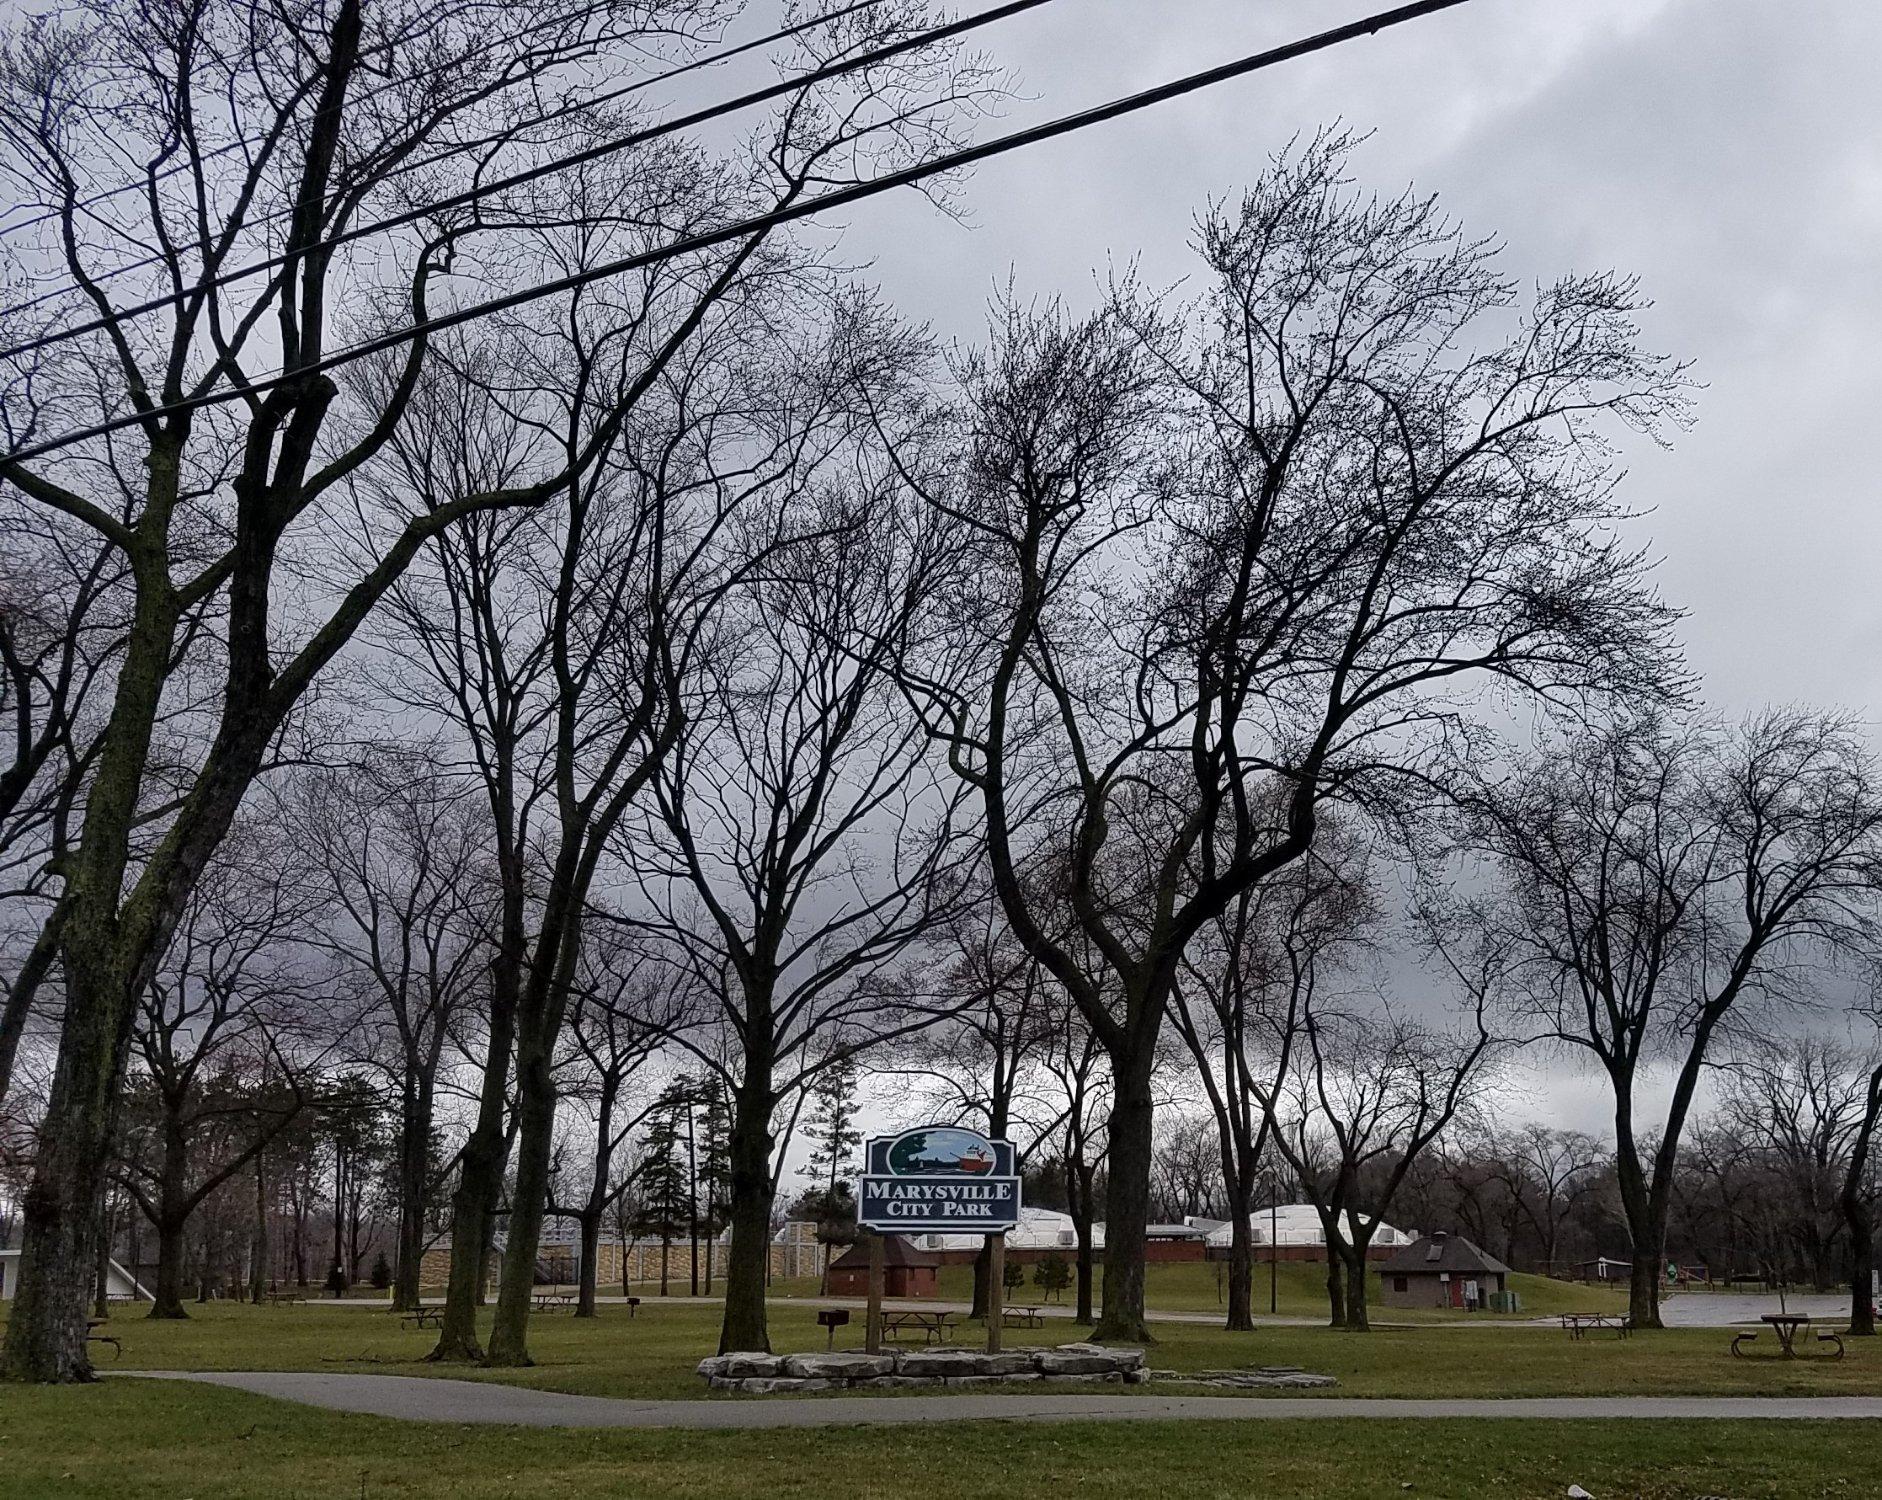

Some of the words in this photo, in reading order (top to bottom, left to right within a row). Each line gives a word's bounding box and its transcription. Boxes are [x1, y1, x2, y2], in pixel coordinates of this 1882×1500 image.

[867, 1182, 1011, 1200] MARYSVILLE
[886, 1201, 933, 1216] CITY
[942, 1201, 993, 1216] PARK
